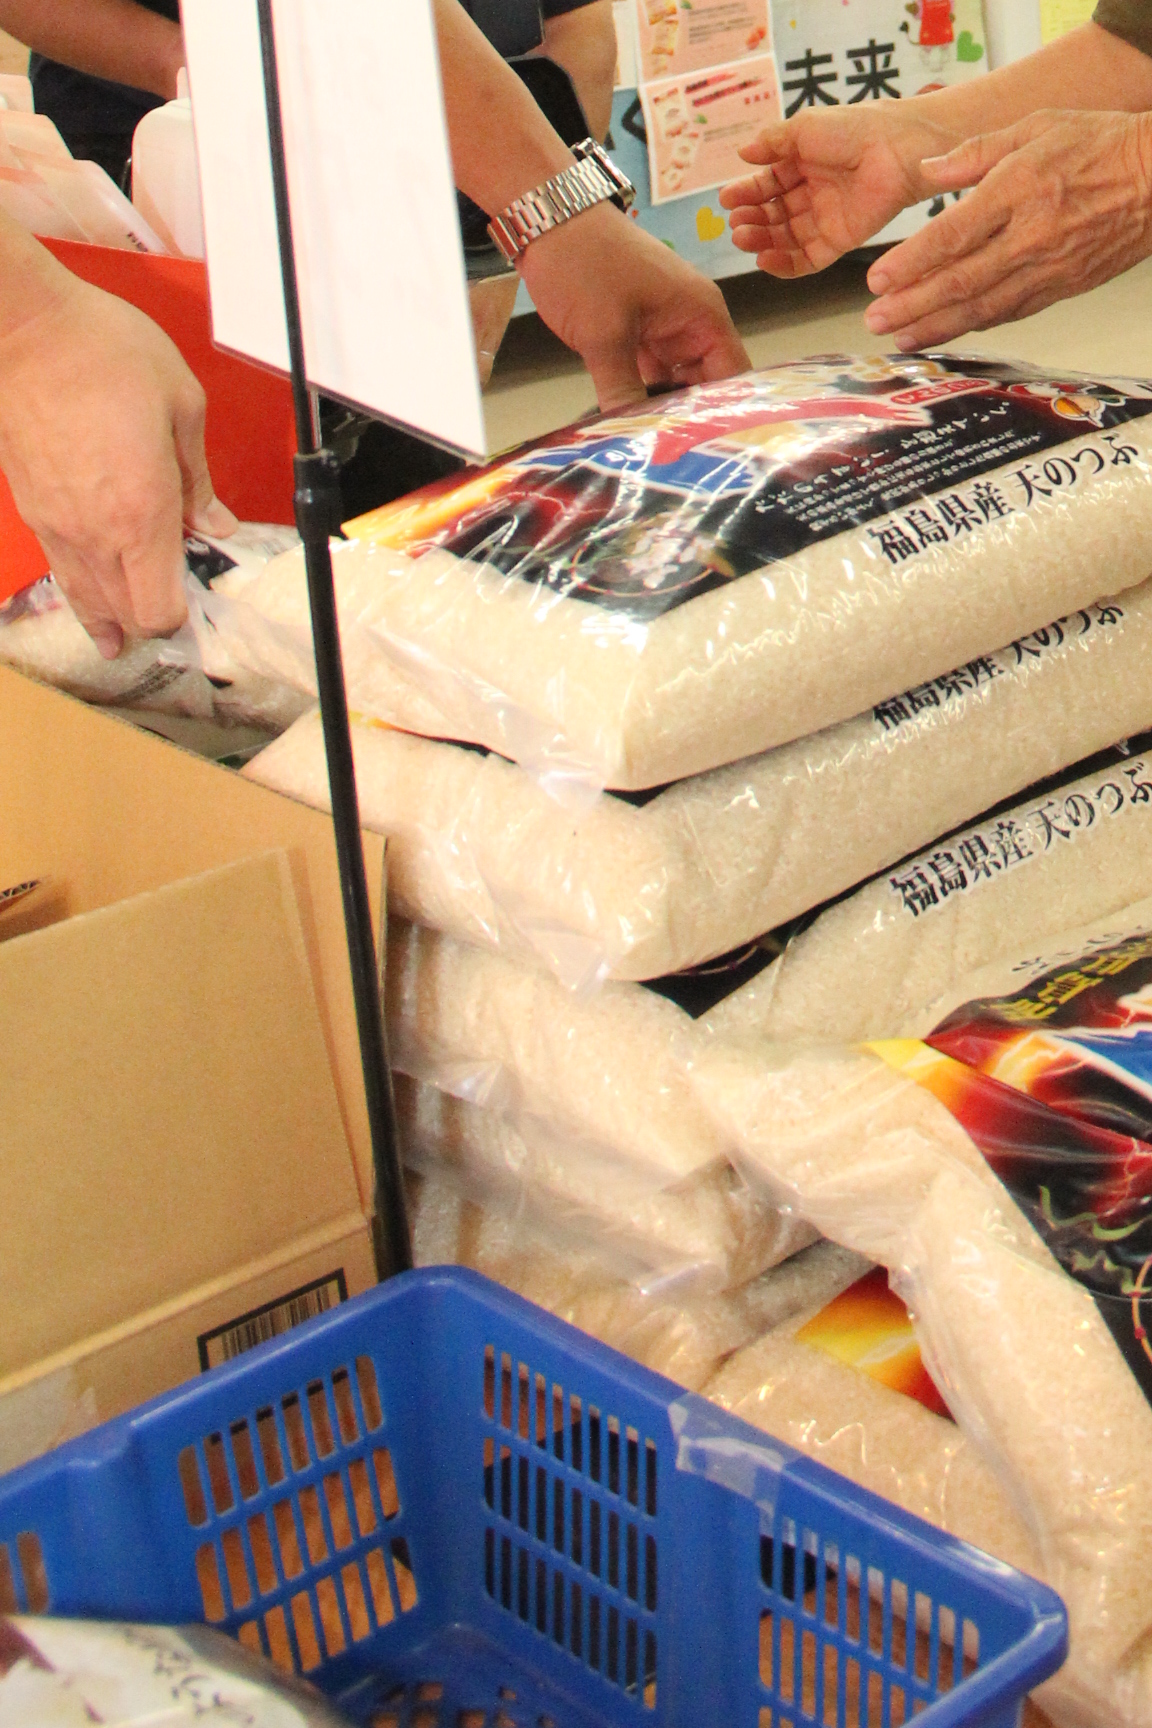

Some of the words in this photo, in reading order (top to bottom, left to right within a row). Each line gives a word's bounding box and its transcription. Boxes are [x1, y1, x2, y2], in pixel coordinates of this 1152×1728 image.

[868, 482, 1016, 564] 福島県産
[1003, 432, 1139, 507] 天のつぶ
[889, 820, 1033, 917] 福島県産
